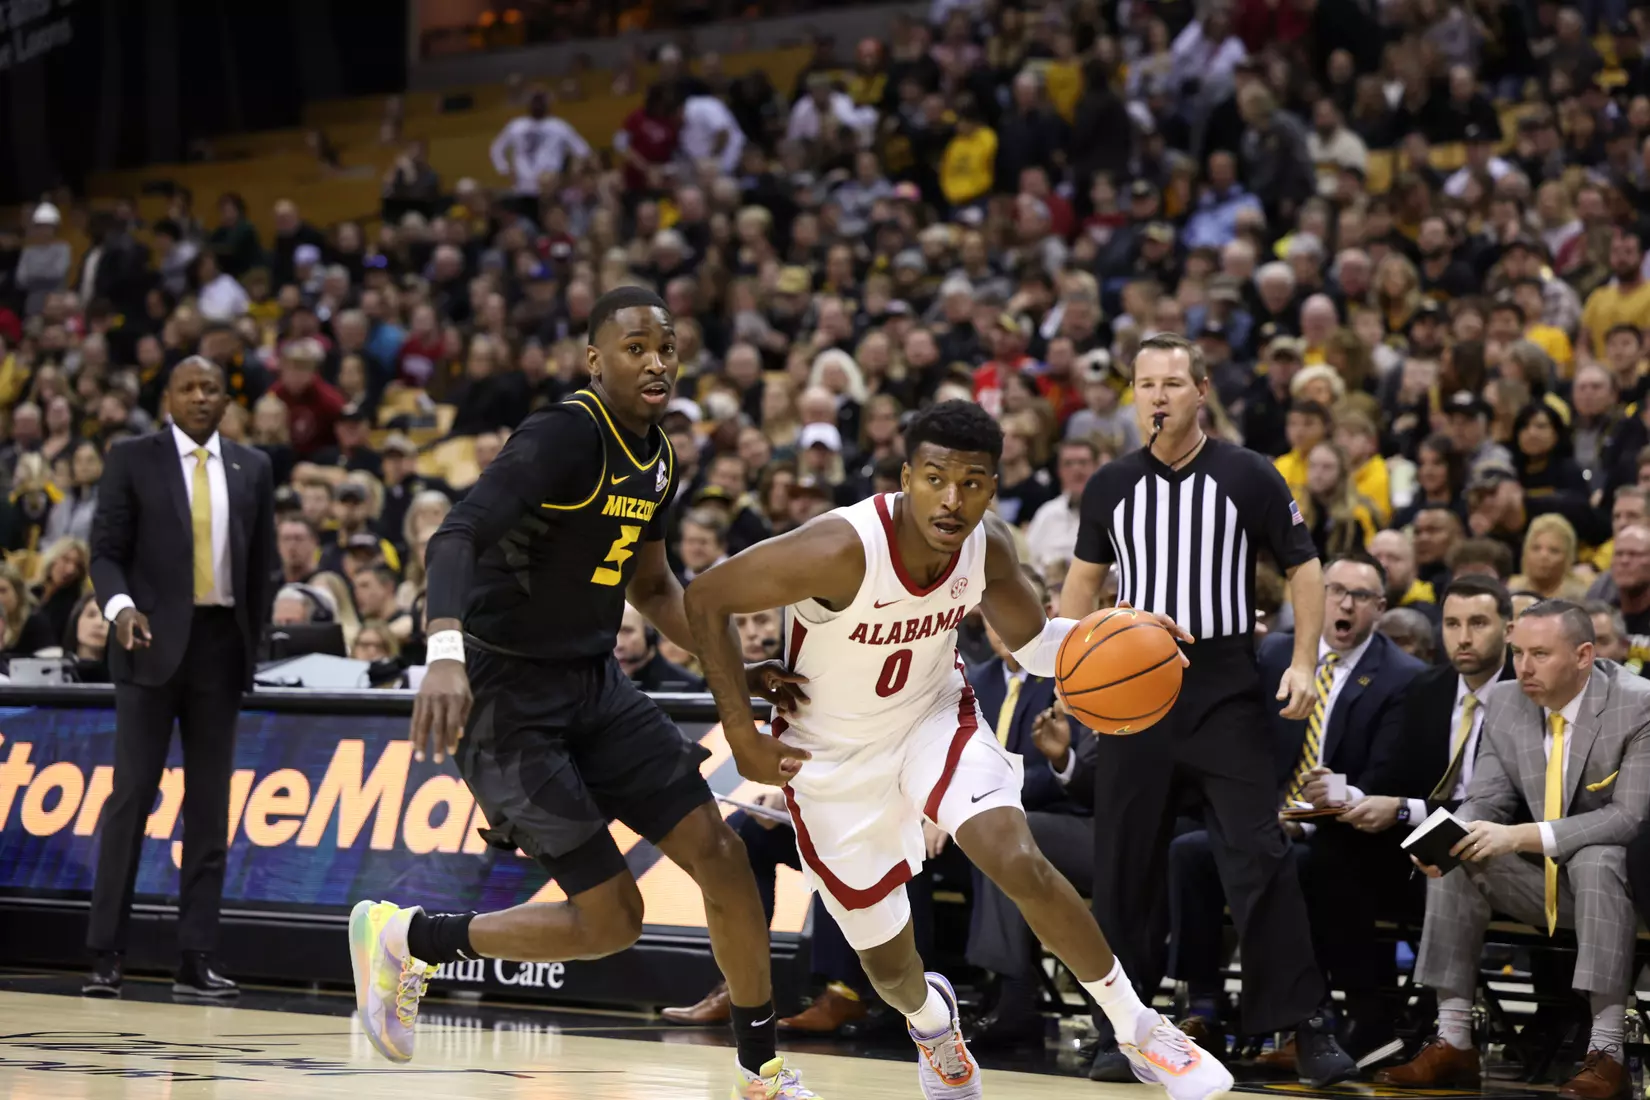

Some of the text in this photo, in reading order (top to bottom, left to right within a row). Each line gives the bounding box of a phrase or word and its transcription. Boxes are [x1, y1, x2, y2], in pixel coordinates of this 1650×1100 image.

[590, 525, 642, 587] 5
[848, 604, 966, 645] ALABAMA
[875, 648, 913, 698] 0
[494, 957, 565, 989] Care
